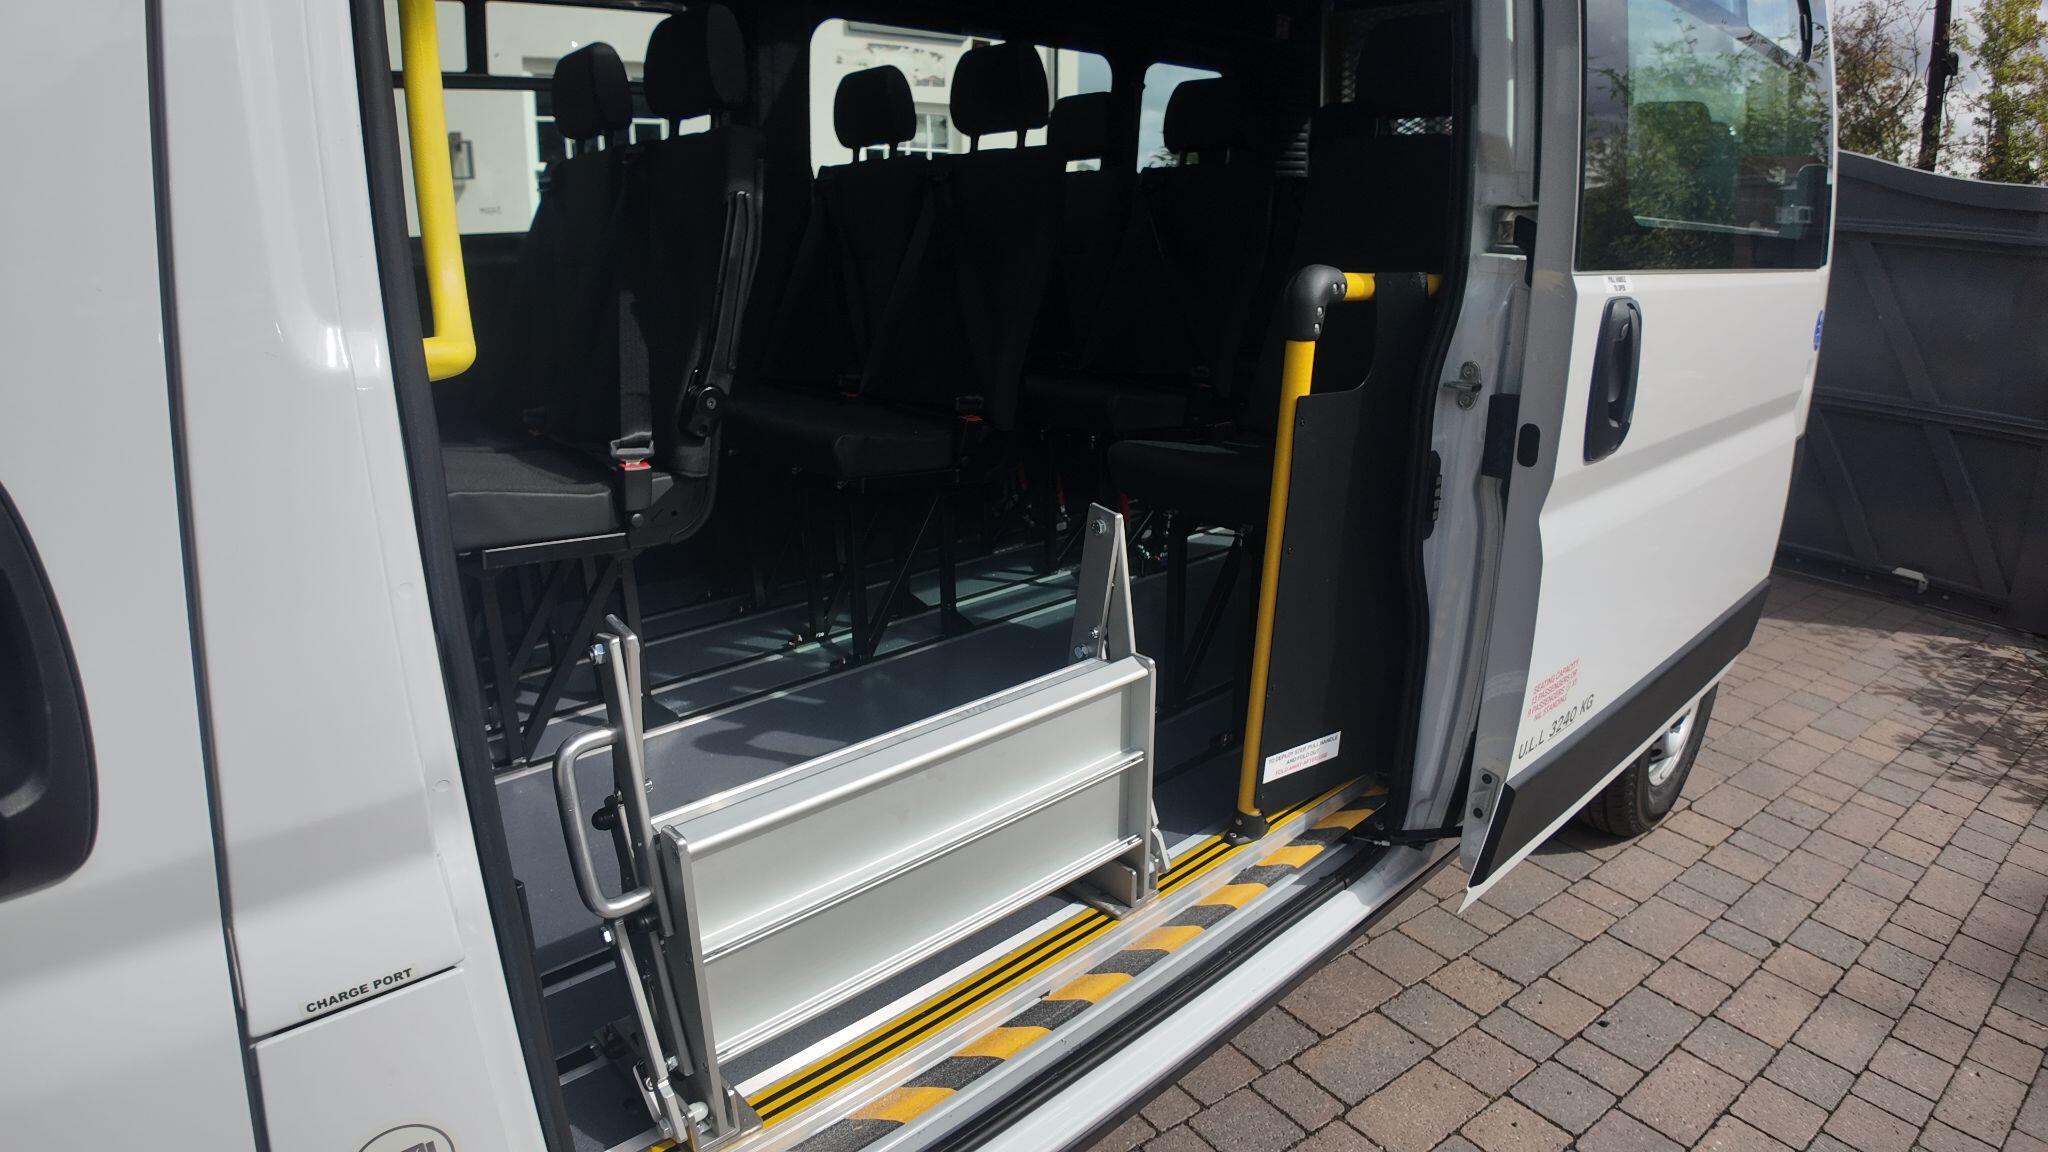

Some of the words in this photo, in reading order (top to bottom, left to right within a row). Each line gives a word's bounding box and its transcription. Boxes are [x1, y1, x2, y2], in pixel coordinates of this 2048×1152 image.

[1549, 706, 1578, 738] 3240
[1580, 693, 1594, 715] KG
[1276, 751, 1294, 762] DEPLOY
[1320, 735, 1338, 746] HANDLE
[1297, 753, 1309, 761] FOLD
[306, 984, 370, 1013] CHARGE
[373, 968, 413, 990] PORT
